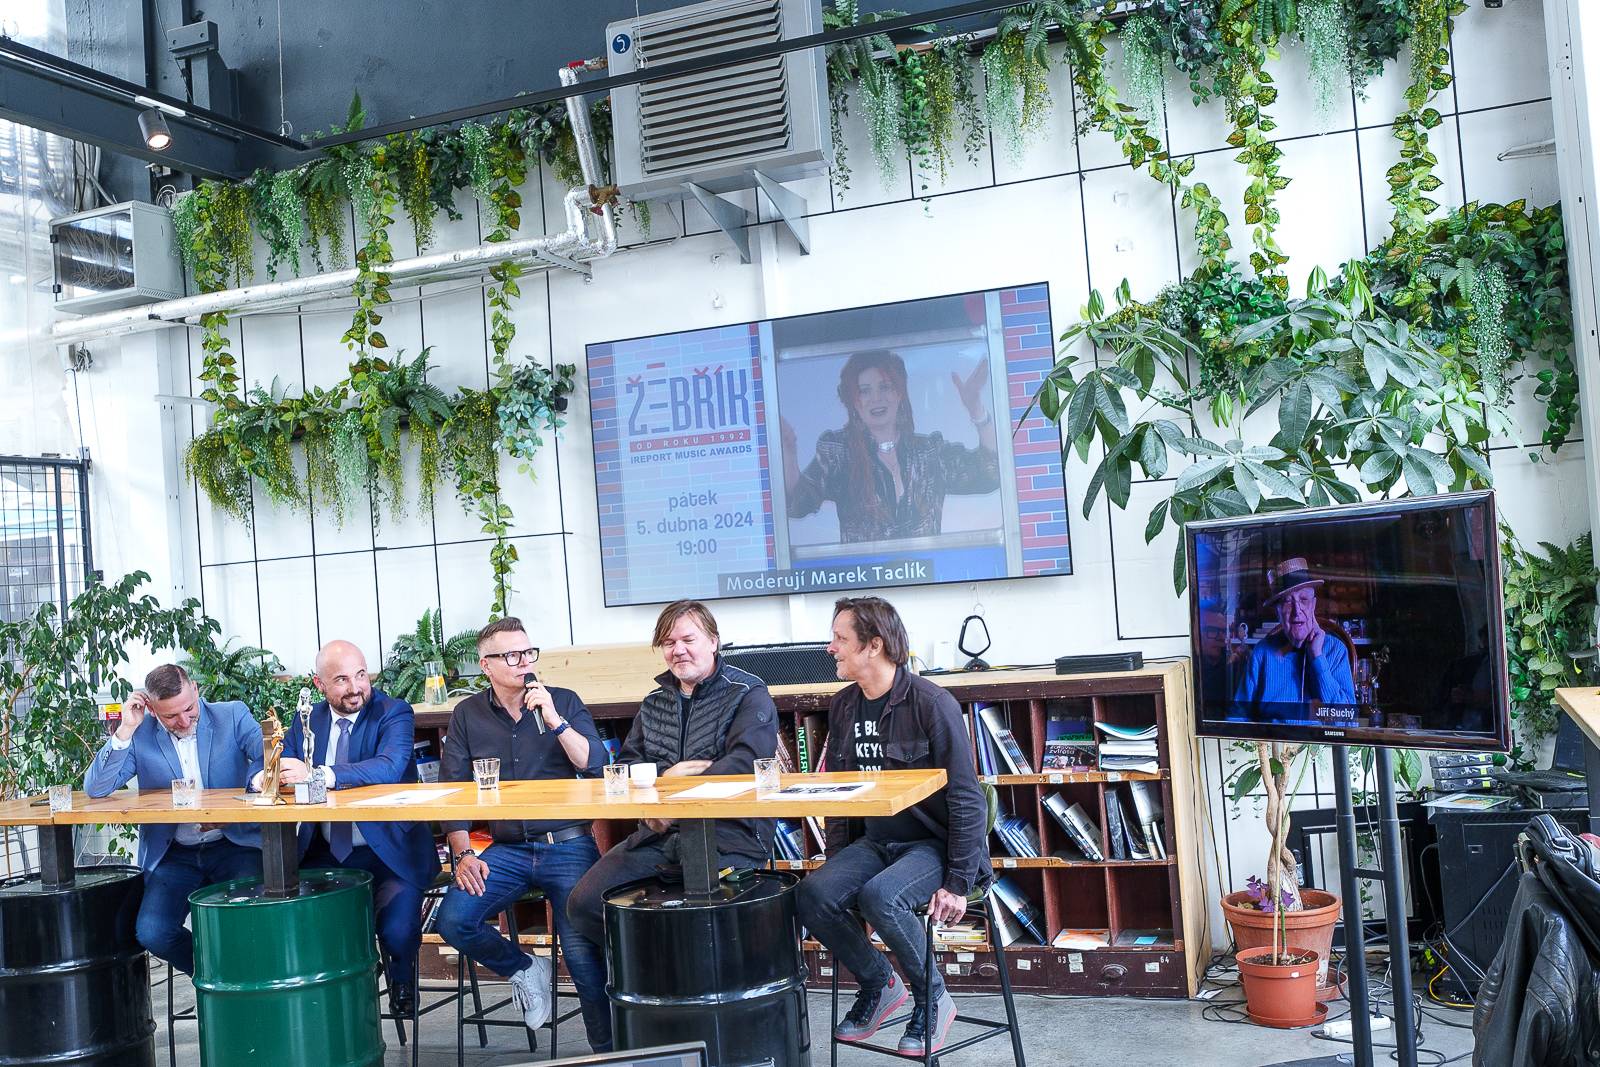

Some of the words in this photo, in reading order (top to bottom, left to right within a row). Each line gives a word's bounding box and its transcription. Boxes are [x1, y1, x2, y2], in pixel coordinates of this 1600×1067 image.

[663, 438, 699, 448] ROKU
[711, 432, 744, 443] 1992
[630, 452, 673, 464] IREPORT
[675, 448, 706, 460] MUSIC
[709, 444, 752, 456] AWARDS
[668, 490, 718, 512] pátek
[637, 520, 651, 535] 5.
[657, 517, 708, 533] dubna
[714, 511, 754, 529] 2024
[676, 538, 717, 556] 19:00
[726, 569, 805, 591] Moderují
[811, 566, 867, 585] Marek
[872, 561, 927, 581] Taclík
[1330, 708, 1355, 720] Suchý
